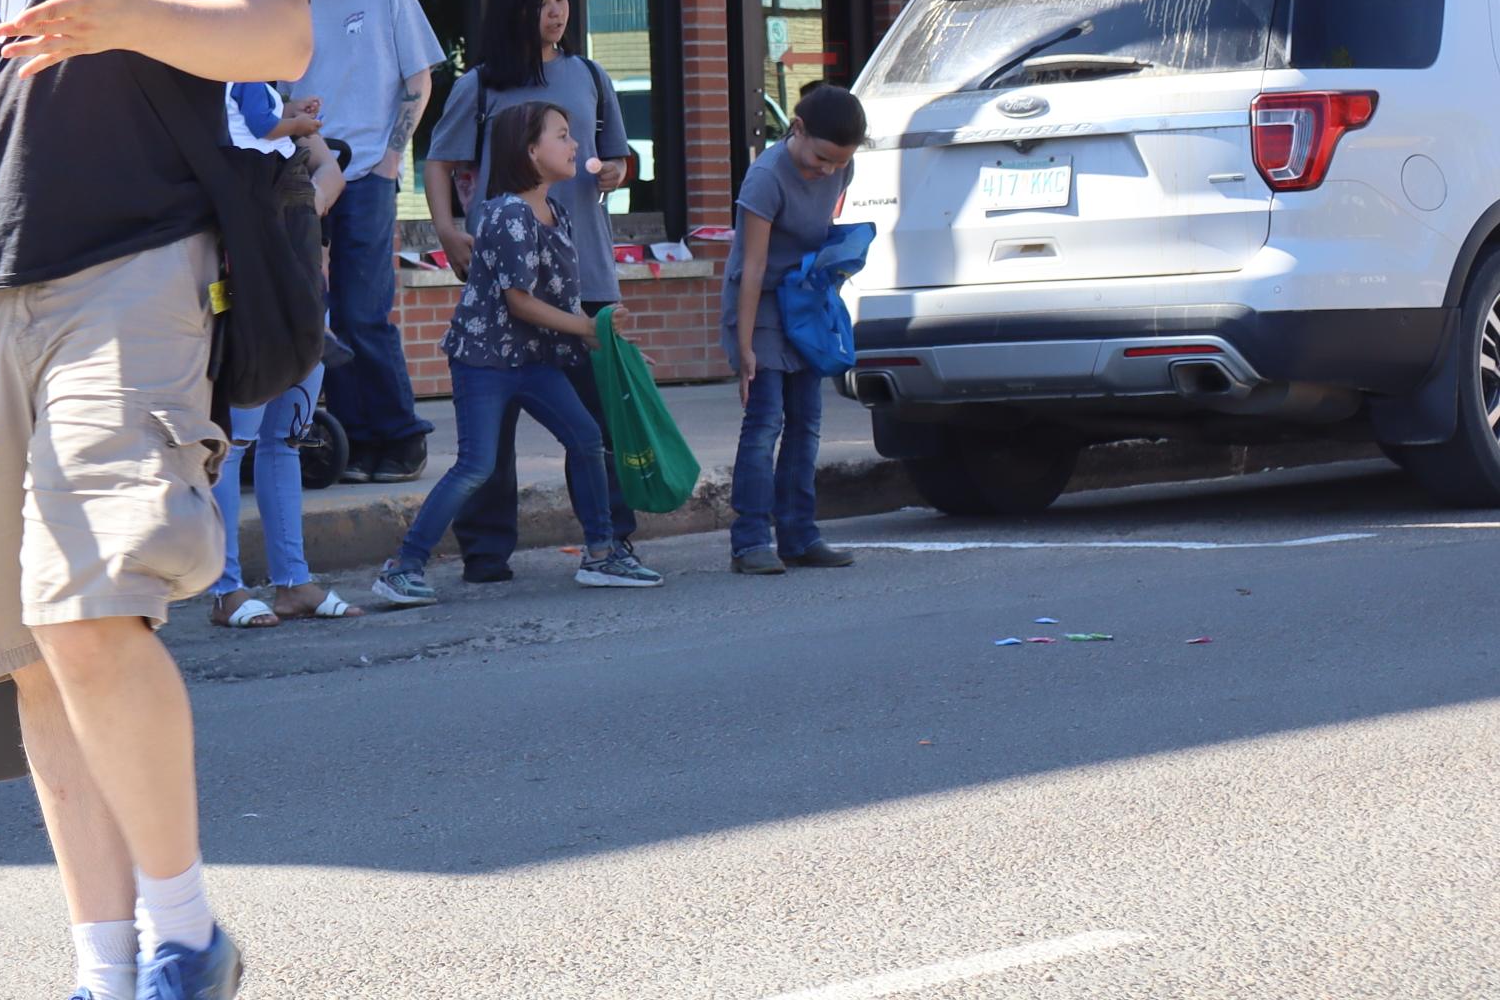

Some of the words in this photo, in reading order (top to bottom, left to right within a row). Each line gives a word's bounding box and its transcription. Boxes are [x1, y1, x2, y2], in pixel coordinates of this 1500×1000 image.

[952, 122, 1093, 142] EXPLORER
[983, 173, 1019, 197] 417
[1030, 171, 1066, 195] KKC
